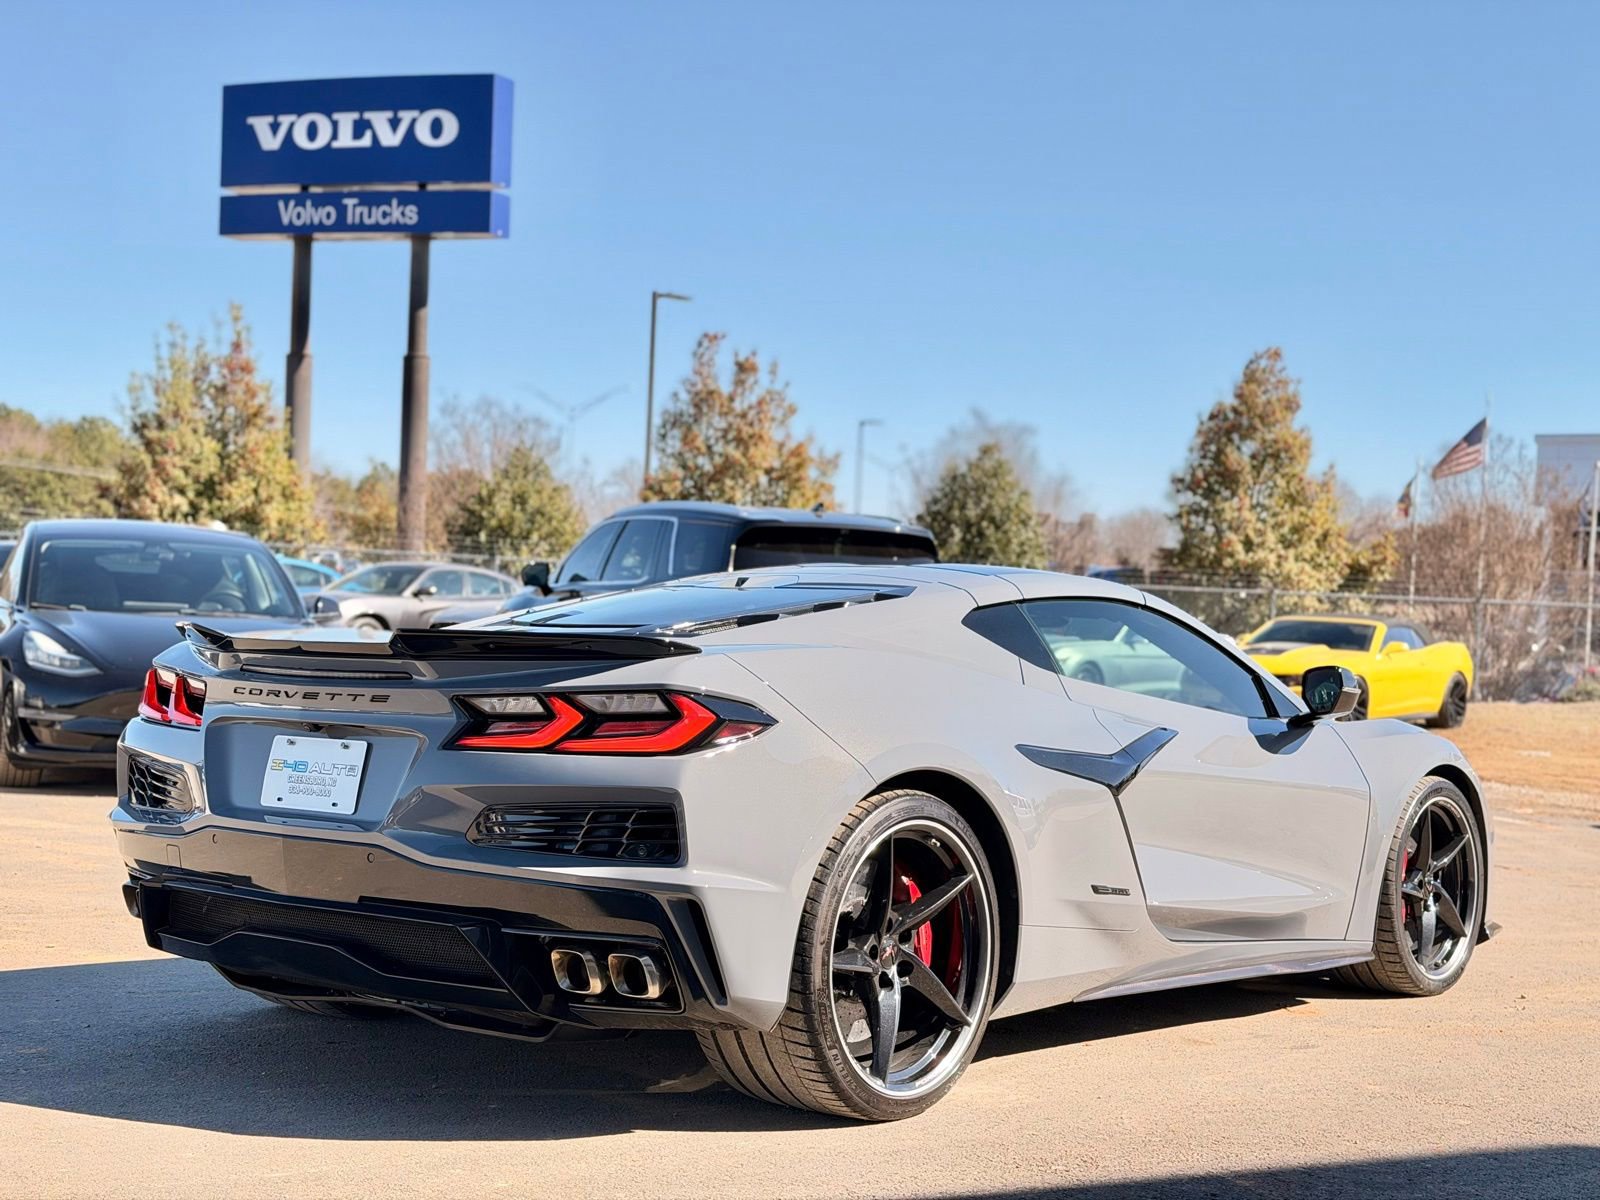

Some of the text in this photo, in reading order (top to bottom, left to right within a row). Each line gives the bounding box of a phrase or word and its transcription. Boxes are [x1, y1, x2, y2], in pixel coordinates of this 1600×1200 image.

[246, 108, 460, 151] VOLVO
[277, 197, 420, 226] Volvo Trucks
[233, 686, 391, 703] CORVETTE
